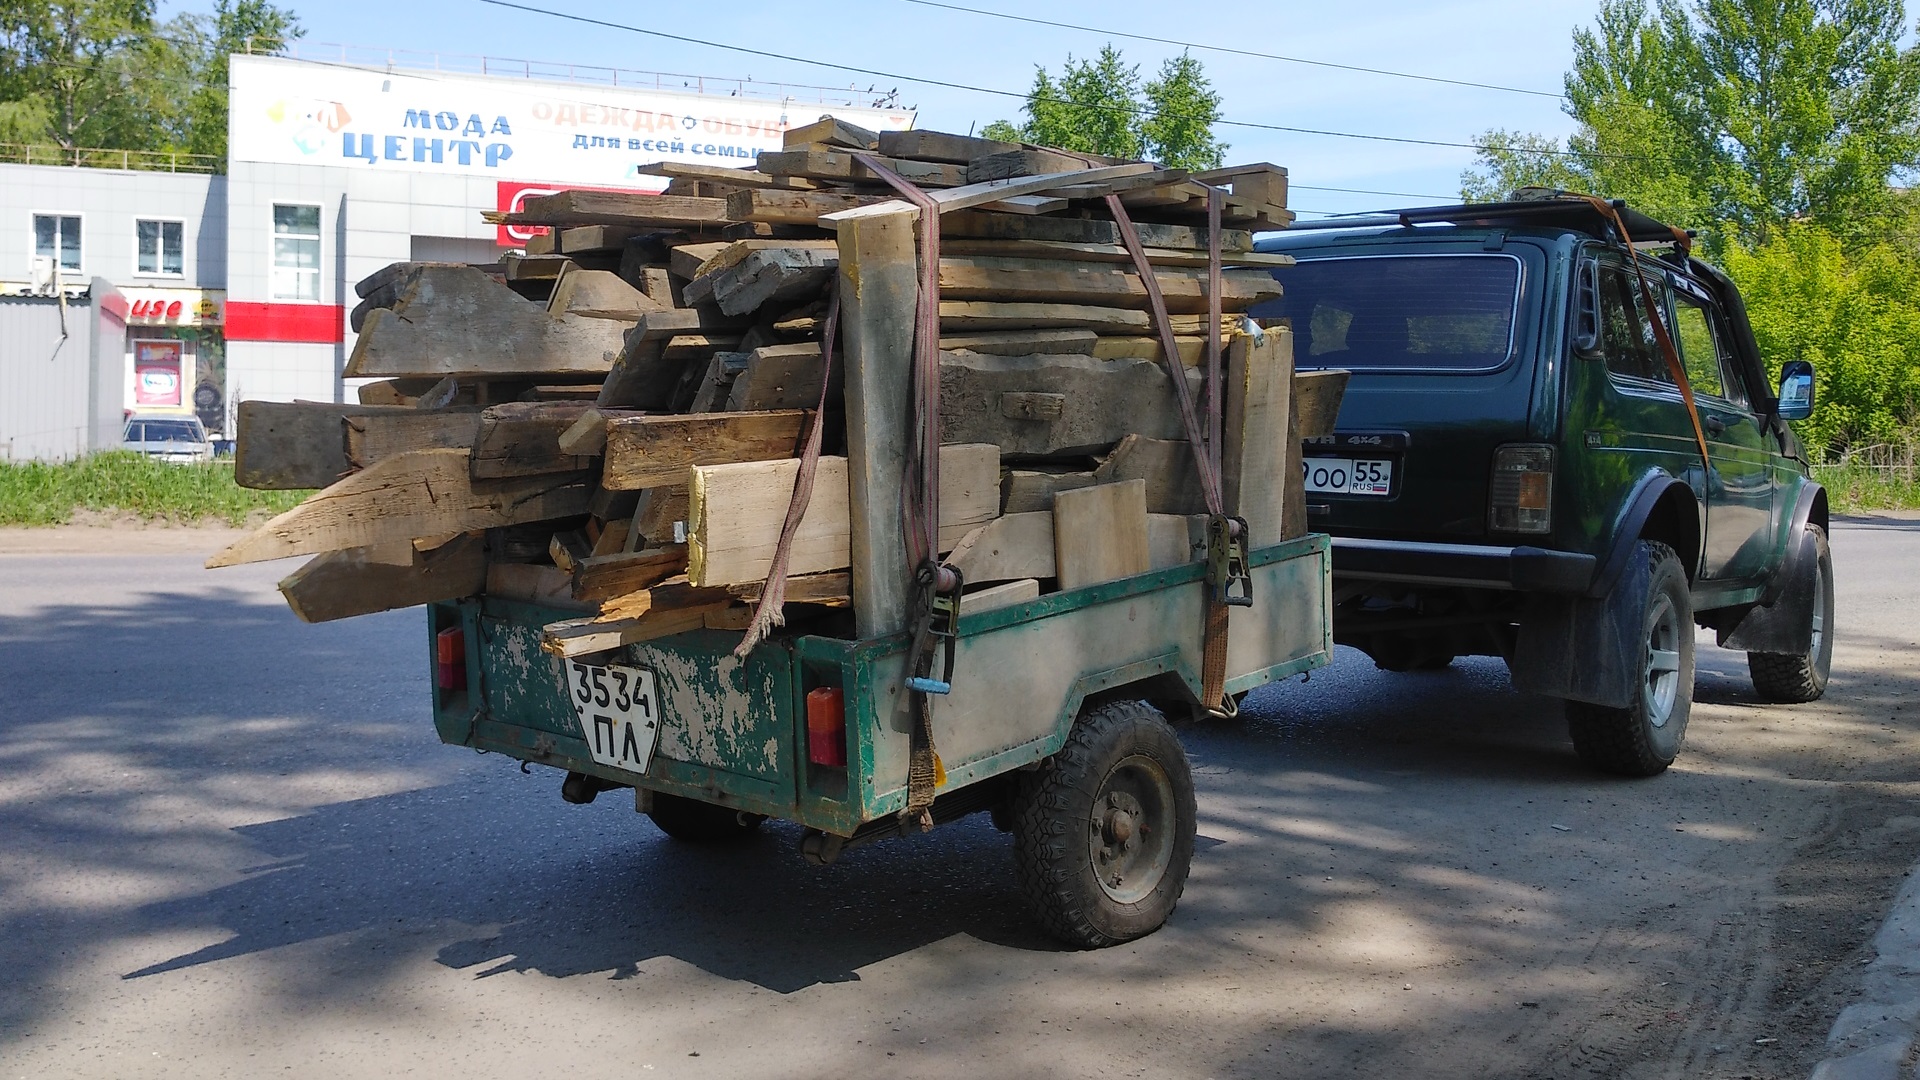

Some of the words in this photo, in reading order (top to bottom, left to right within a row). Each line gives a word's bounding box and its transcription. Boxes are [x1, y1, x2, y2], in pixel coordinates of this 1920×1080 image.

[403, 108, 512, 138] МОДА
[531, 101, 677, 133] ОДЕЖДА
[343, 132, 514, 168] ЦЕНТР
[572, 133, 621, 150] для
[628, 136, 684, 154] всей
[691, 143, 764, 159] семьи
[126, 299, 183, 318] use
[1352, 482, 1372, 491] RUS
[1354, 461, 1382, 482] 55
[573, 664, 650, 718] 3534
[593, 714, 641, 765] ПЛ
